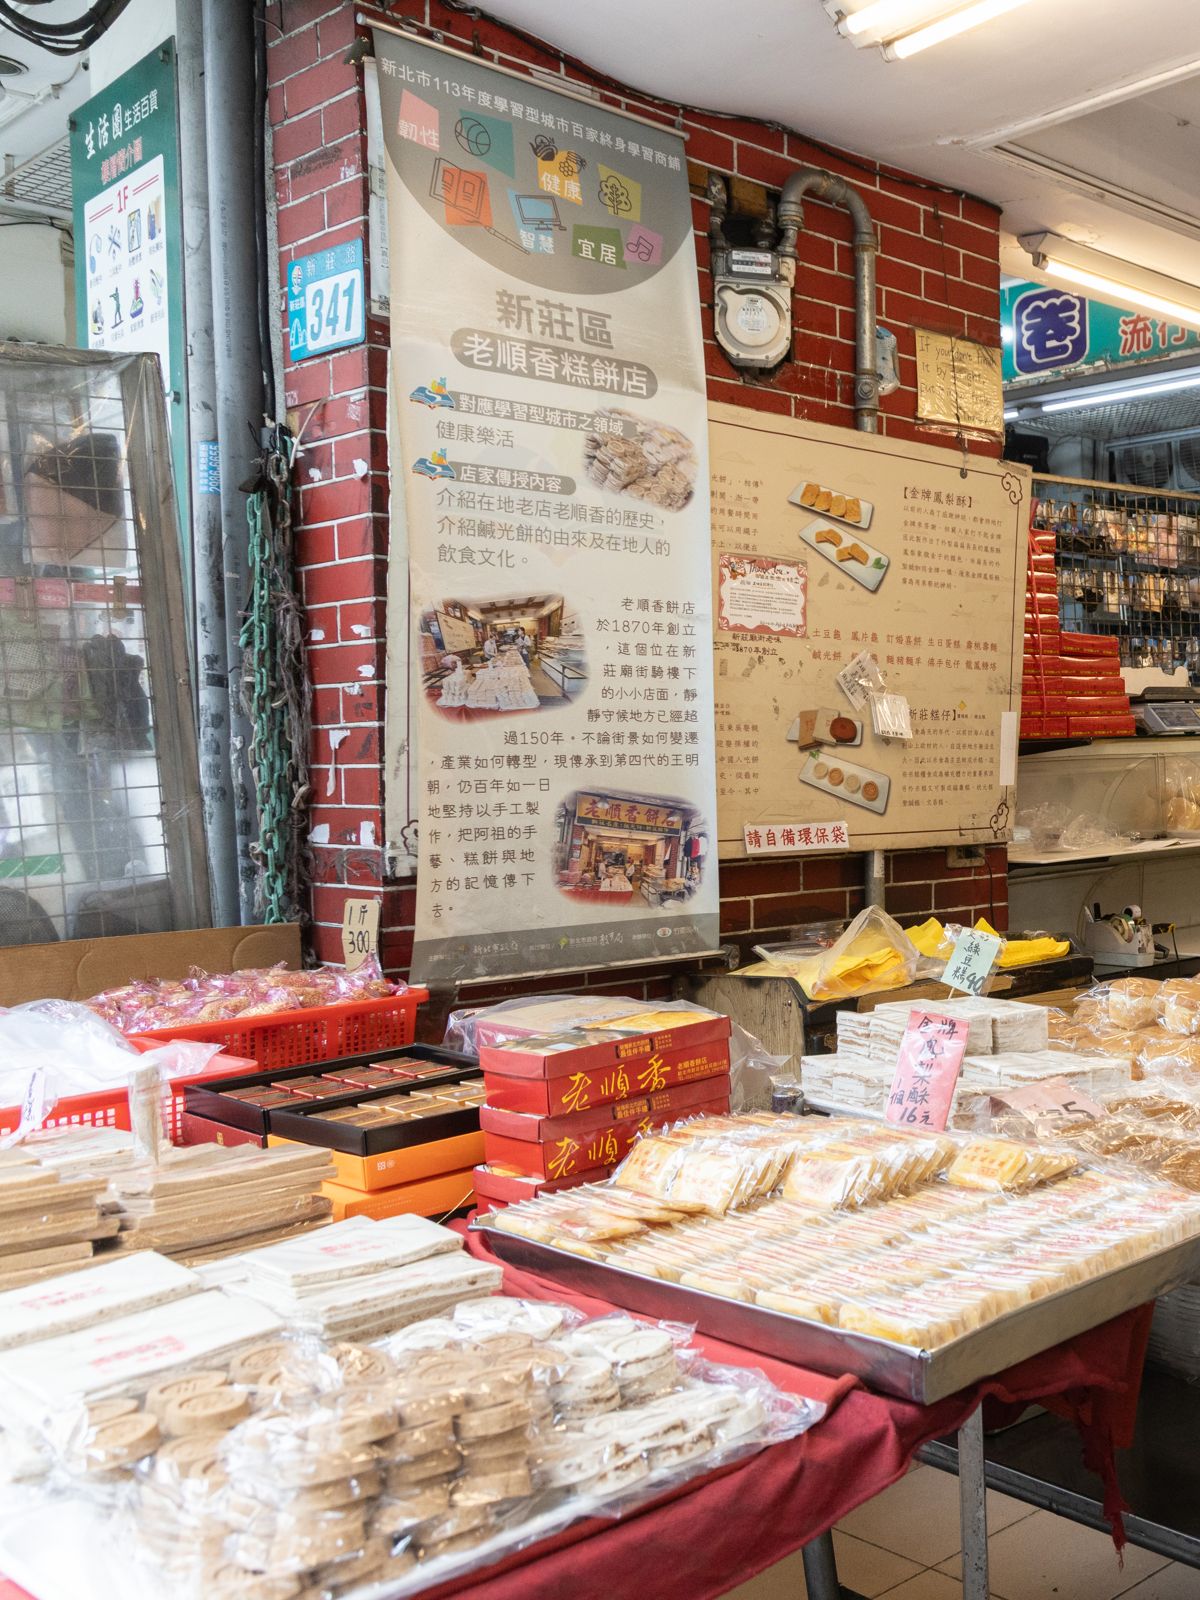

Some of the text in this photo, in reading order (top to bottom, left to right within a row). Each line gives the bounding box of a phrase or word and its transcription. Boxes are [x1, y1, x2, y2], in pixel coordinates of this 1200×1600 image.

[399, 118, 440, 148] 韌性
[541, 171, 583, 201] 健康
[117, 185, 128, 213] 1F
[520, 229, 555, 255] 智慧
[578, 238, 616, 266] 宜居
[310, 277, 356, 341] 341
[496, 288, 614, 350] 新莊區
[463, 332, 648, 396] 老順香糕餅店
[459, 394, 624, 436] 對應學習型城市之領域
[435, 419, 514, 449] 健康樂活
[460, 465, 562, 493] 店家傳授內容
[436, 486, 665, 530] 介紹在地老店老順香的歷史，
[436, 514, 671, 557] 介紹鹹光餅的由來及在地人的
[437, 543, 529, 570] 飲食文化。
[621, 597, 695, 615] 老順香餅店
[596, 618, 697, 636] 於1870年創立
[606, 641, 697, 658] ，這個位在新
[603, 663, 697, 680] 莊廟街騎樓下
[601, 685, 698, 702] 的小小店面，靜
[587, 709, 699, 724] 靜守候地方已經超
[503, 730, 699, 746] 過150年。不論街景如何變遷
[427, 777, 551, 794] 朝，仍百年如一日
[428, 801, 541, 819] 地堅持以手工製
[429, 824, 538, 844] 作，把阿祖的手
[746, 826, 847, 849] 請自備環保袋
[429, 849, 536, 869] 藝、糕餅與地
[430, 872, 536, 893] 方的記憶傳下
[431, 903, 454, 918] 去。
[562, 1053, 671, 1114] 老順香
[899, 1107, 934, 1126] 16元
